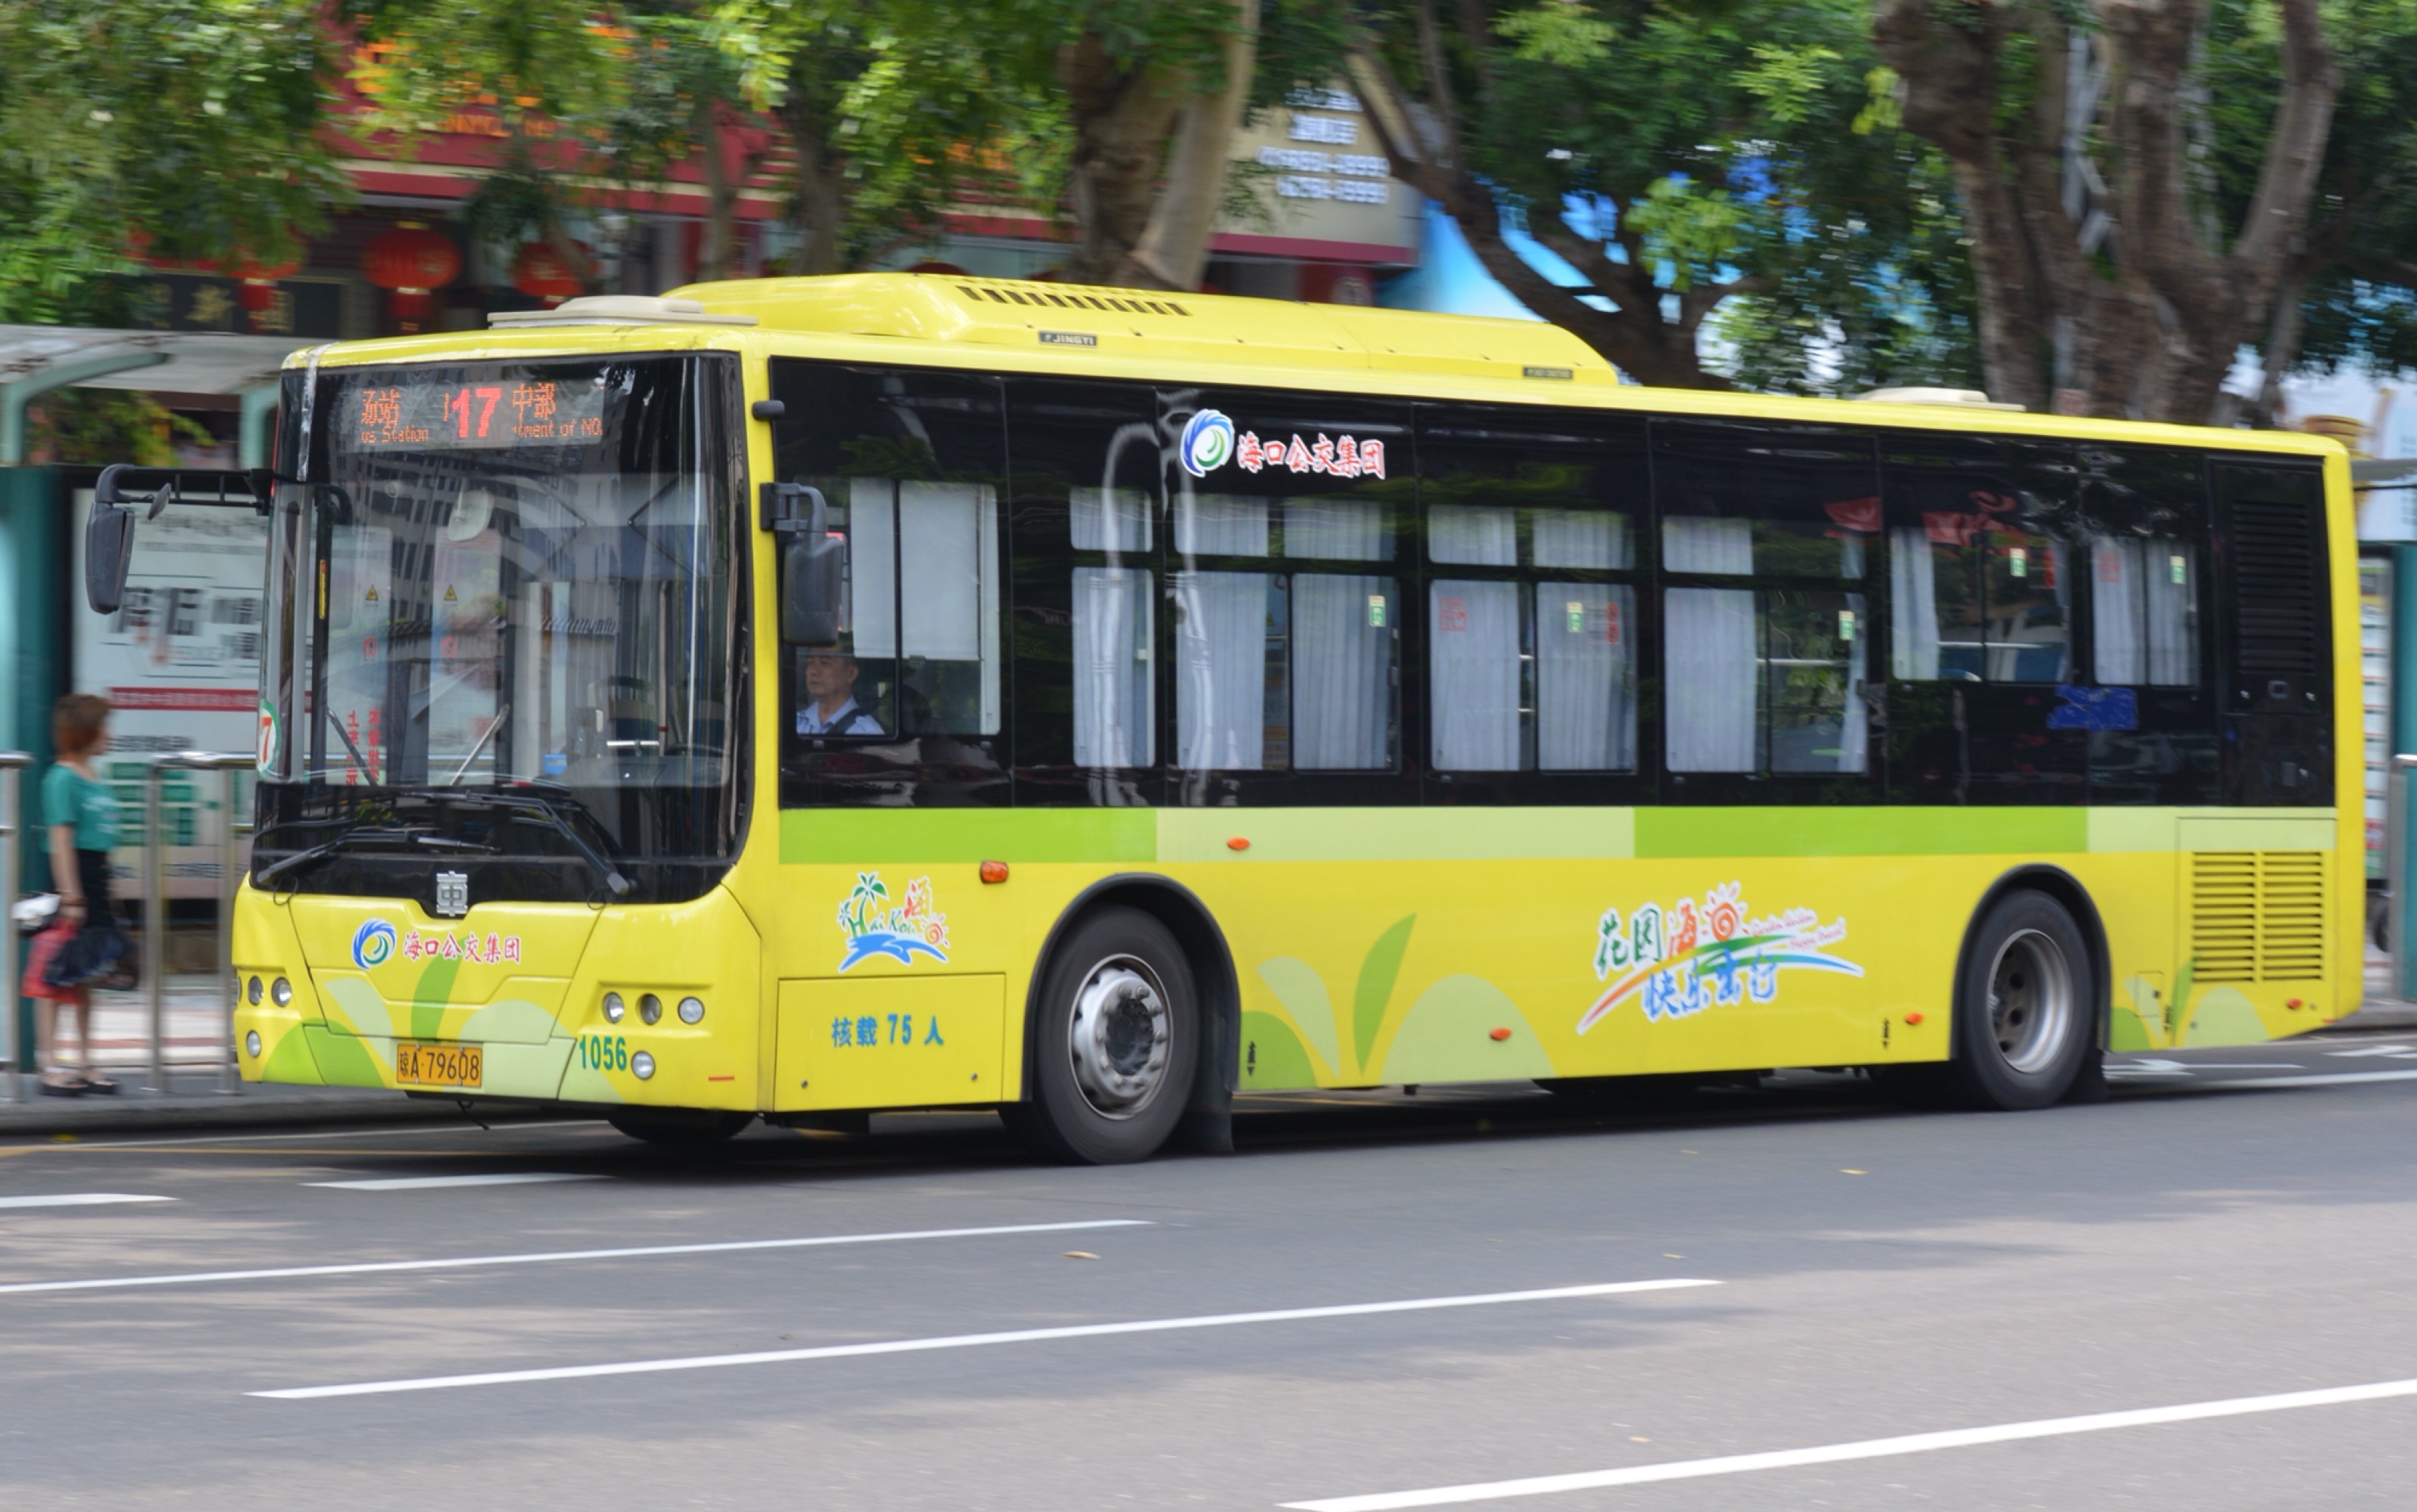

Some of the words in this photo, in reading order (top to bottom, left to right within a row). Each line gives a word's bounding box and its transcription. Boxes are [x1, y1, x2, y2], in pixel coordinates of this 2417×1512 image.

[451, 387, 502, 438] 17
[1237, 431, 1385, 480] 海口公交集团
[404, 931, 520, 963] 海口公交集团
[832, 1016, 878, 1048] 核载
[887, 1013, 912, 1045] 75
[923, 1014, 945, 1046] 人
[579, 1034, 627, 1071] 1056
